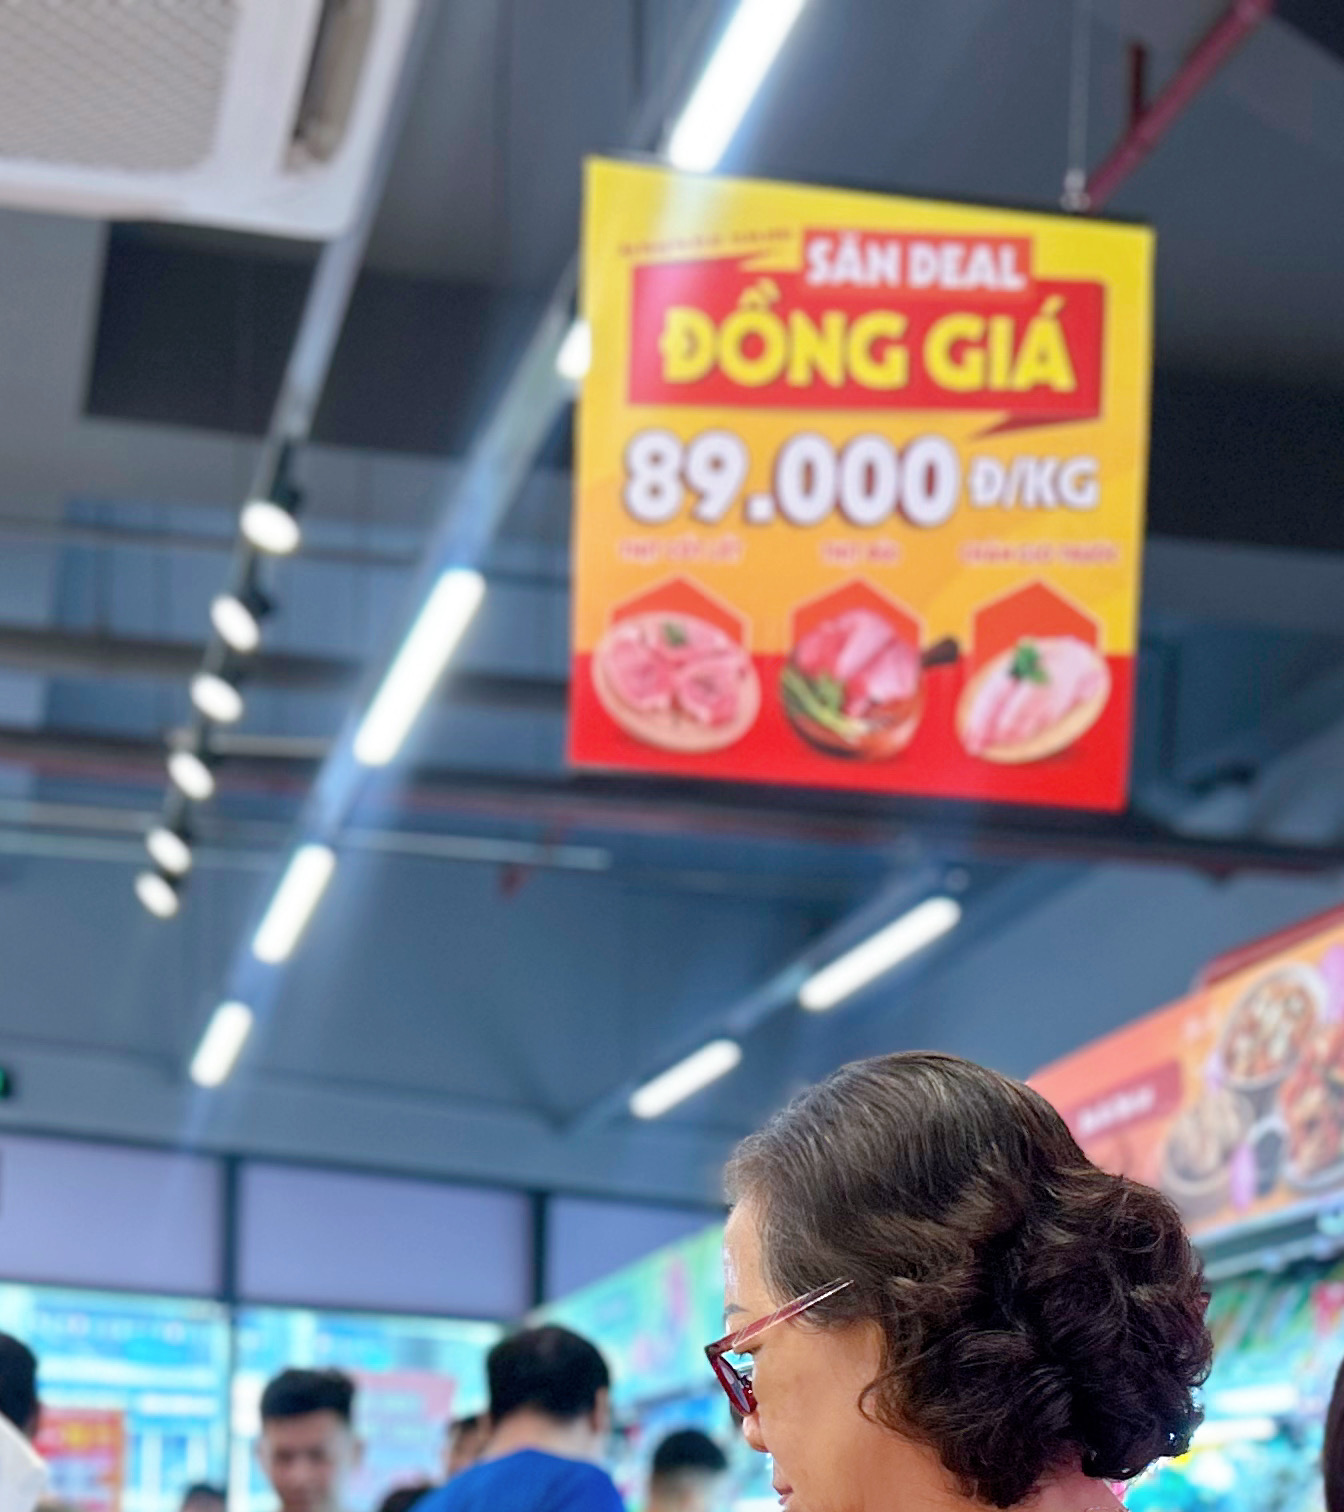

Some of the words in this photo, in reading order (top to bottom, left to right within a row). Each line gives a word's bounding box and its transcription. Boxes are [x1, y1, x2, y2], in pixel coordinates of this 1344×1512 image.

[805, 230, 900, 289] SĂN
[907, 241, 1027, 290] DEAL
[660, 277, 910, 388] ĐỒNG
[923, 295, 1076, 393] GIÁ
[623, 428, 961, 527] 89.000
[967, 455, 1101, 512] Đ/KG
